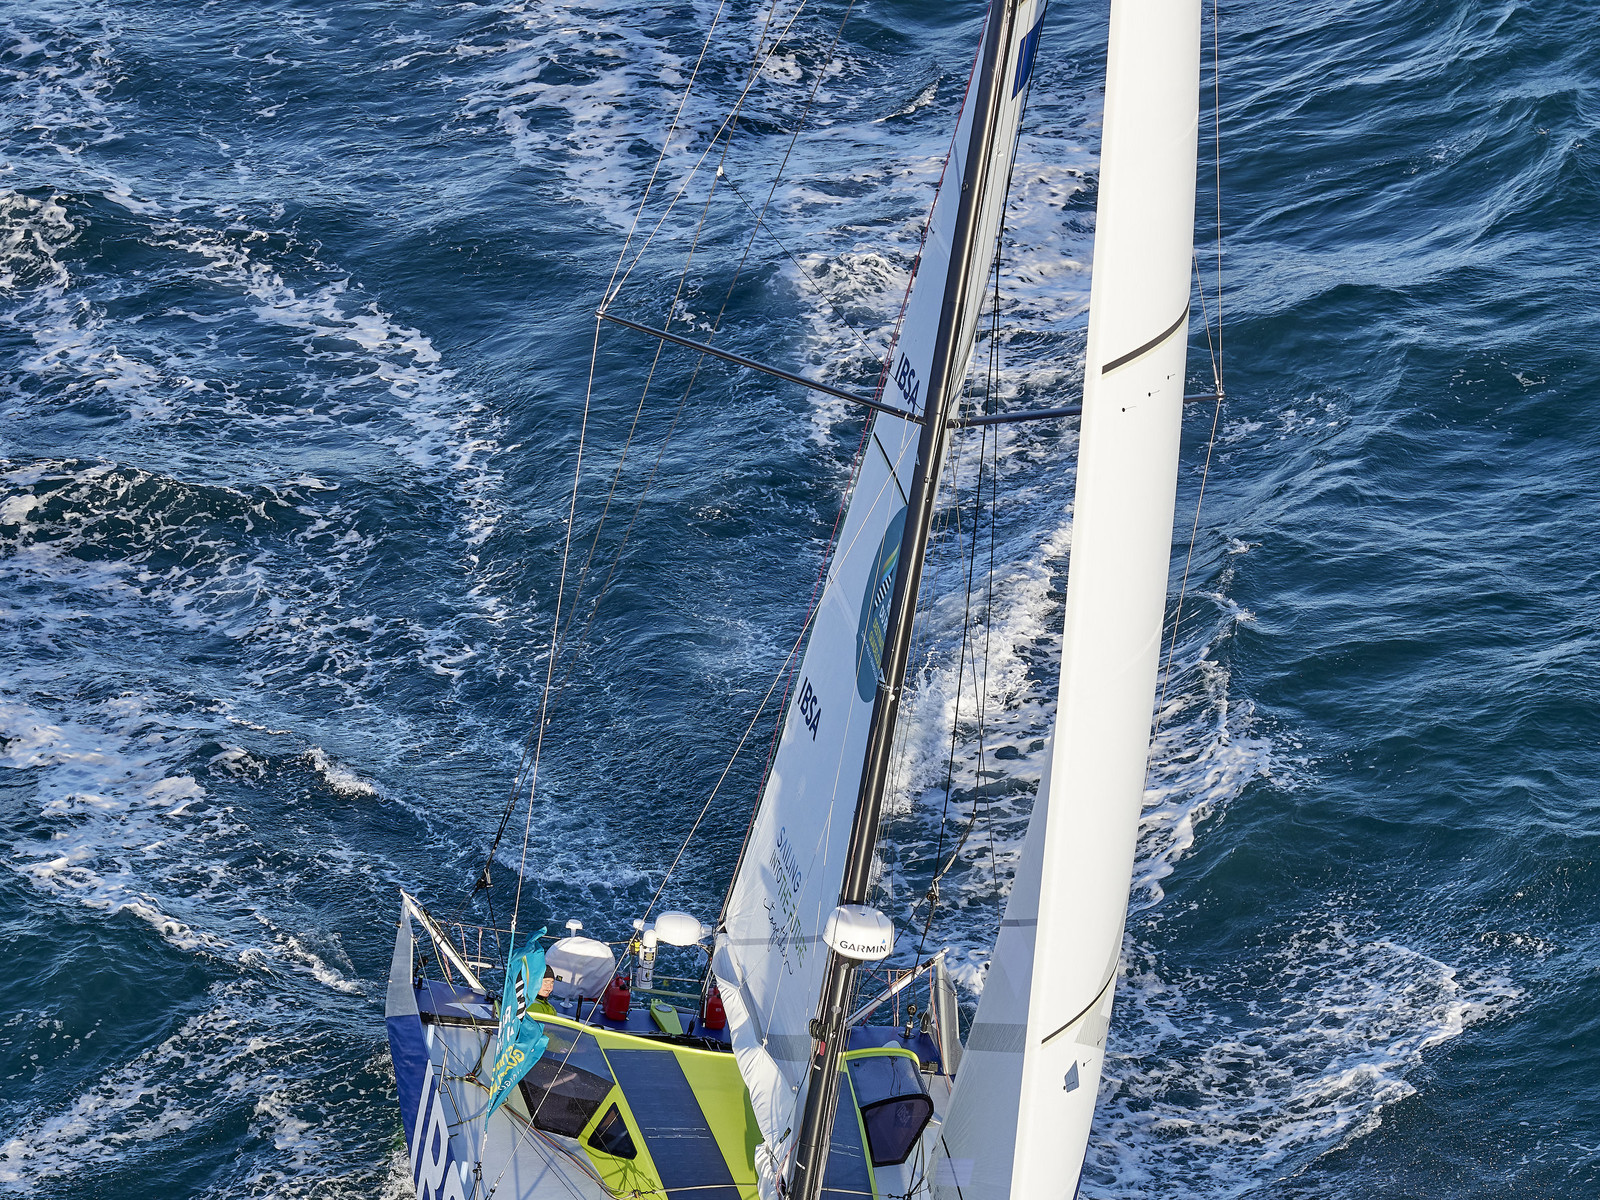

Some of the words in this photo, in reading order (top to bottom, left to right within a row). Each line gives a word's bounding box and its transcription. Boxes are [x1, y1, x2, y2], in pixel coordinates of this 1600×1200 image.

[895, 352, 920, 413] IBSA
[797, 676, 821, 742] IBSA
[777, 826, 802, 893] SAILING
[839, 940, 887, 953] GARMIN
